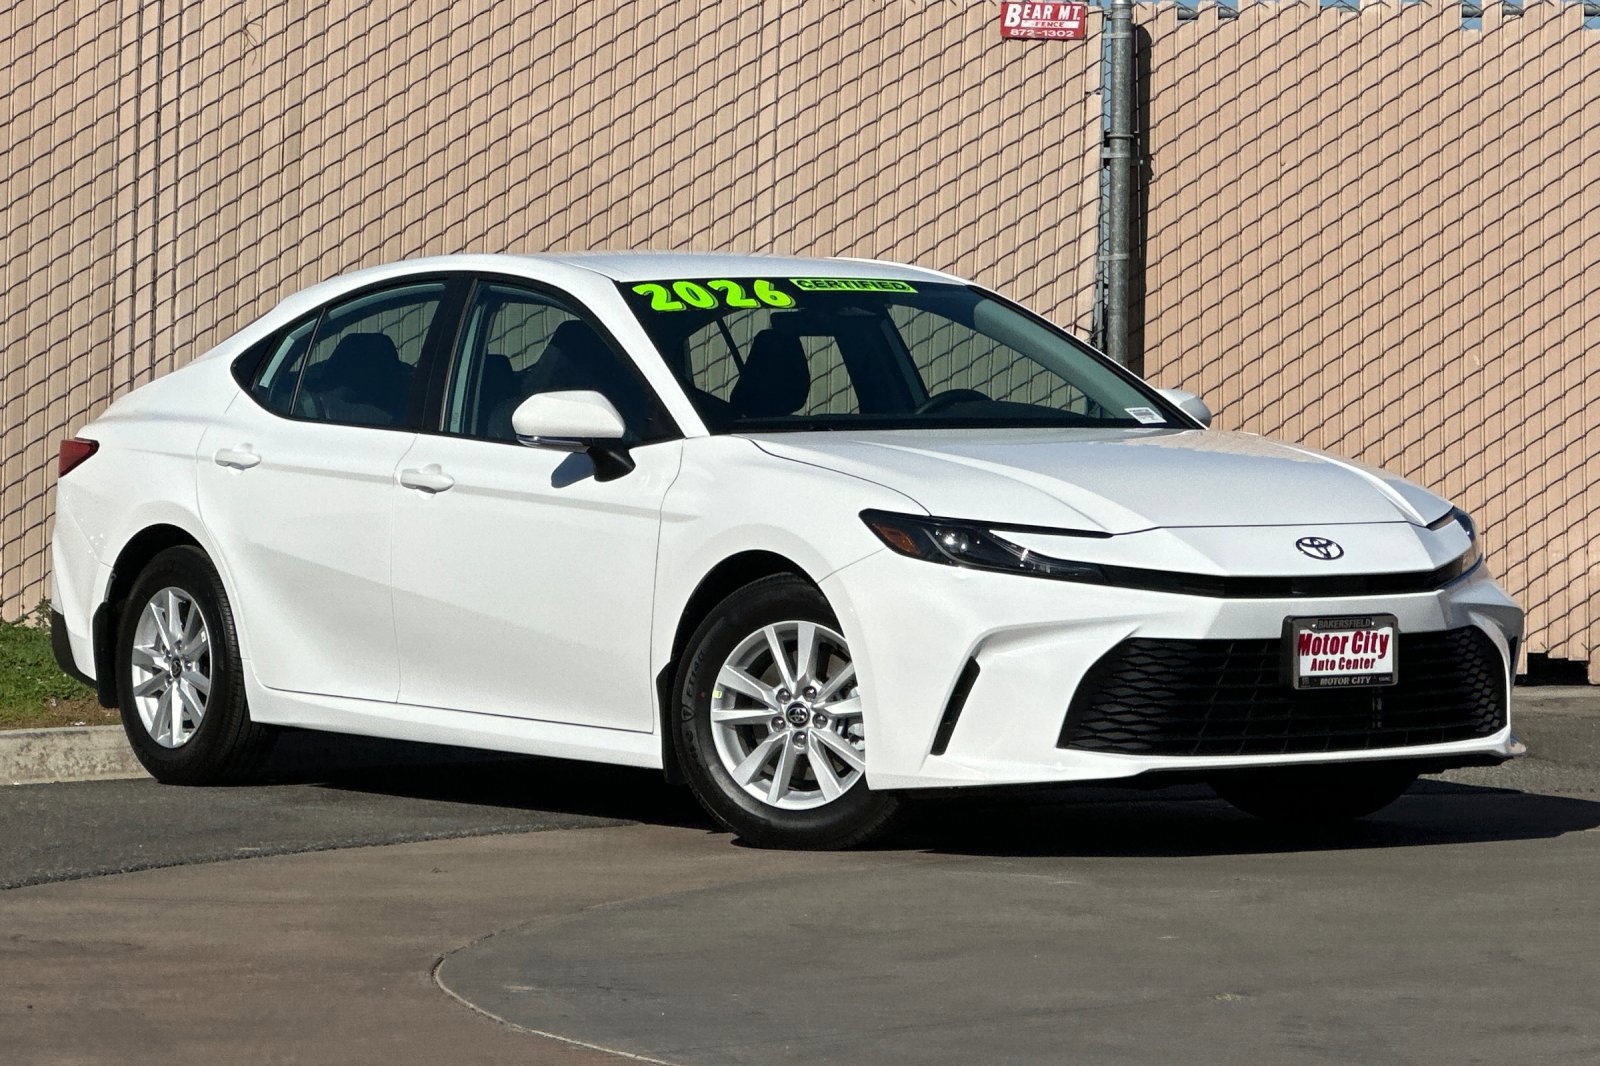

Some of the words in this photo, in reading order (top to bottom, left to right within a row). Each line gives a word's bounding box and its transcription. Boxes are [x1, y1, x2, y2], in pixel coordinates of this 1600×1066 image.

[1004, 3, 1053, 27] BEAR
[1058, 5, 1081, 20] MT.
[1010, 28, 1074, 37] 872-1302
[797, 279, 911, 291] CERTIFIED
[632, 279, 796, 311] 2026
[1319, 619, 1371, 629] BAKERSFIELD
[1298, 633, 1349, 656] Motor
[1351, 631, 1389, 659] City
[1310, 658, 1336, 671] Auto
[1338, 657, 1375, 670] Center
[1320, 677, 1350, 686] MOTOR
[1351, 676, 1371, 684] CITY
